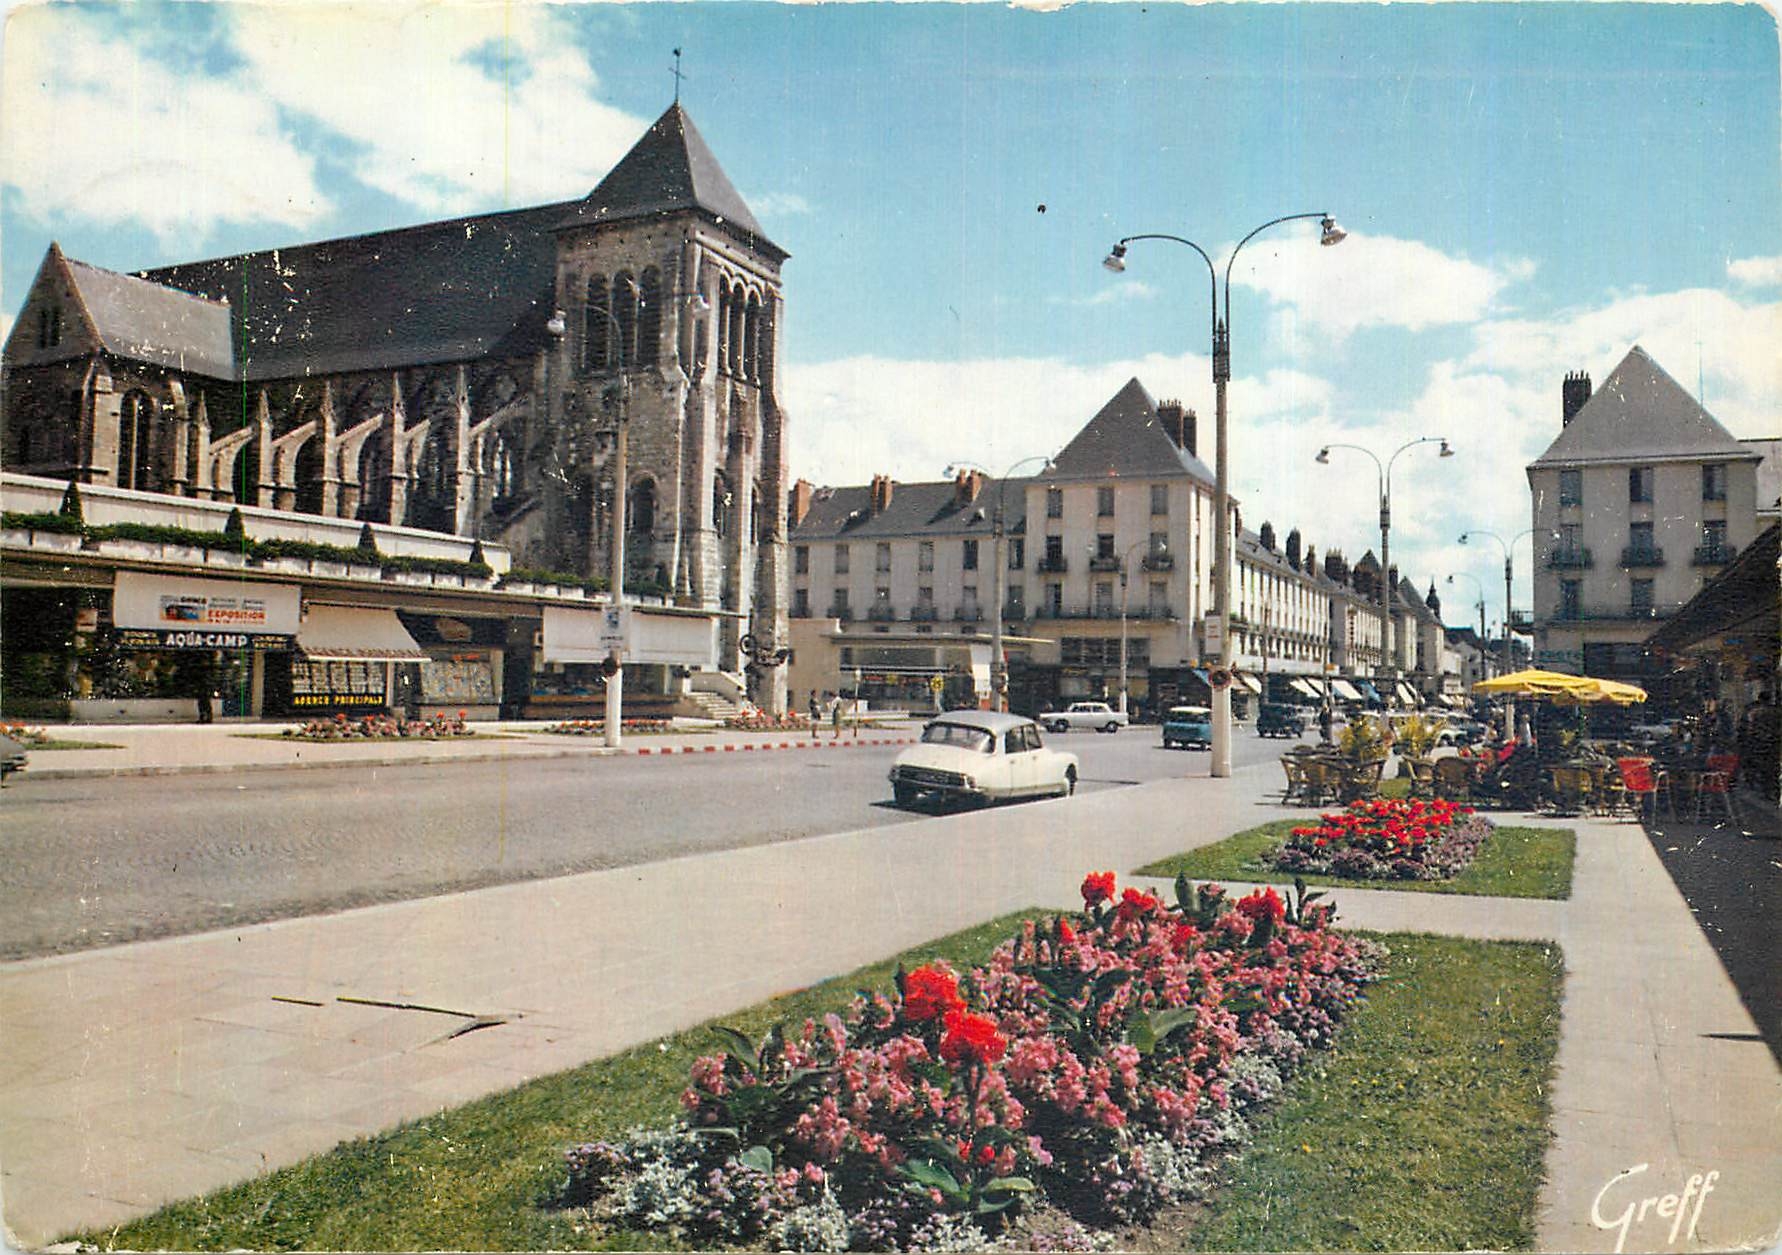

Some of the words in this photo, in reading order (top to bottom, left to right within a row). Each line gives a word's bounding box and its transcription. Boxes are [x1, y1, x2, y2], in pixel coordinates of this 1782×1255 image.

[208, 610, 266, 620] EXPOSITION
[166, 632, 248, 647] AQUA-CAMP
[294, 696, 329, 705] AGENCE
